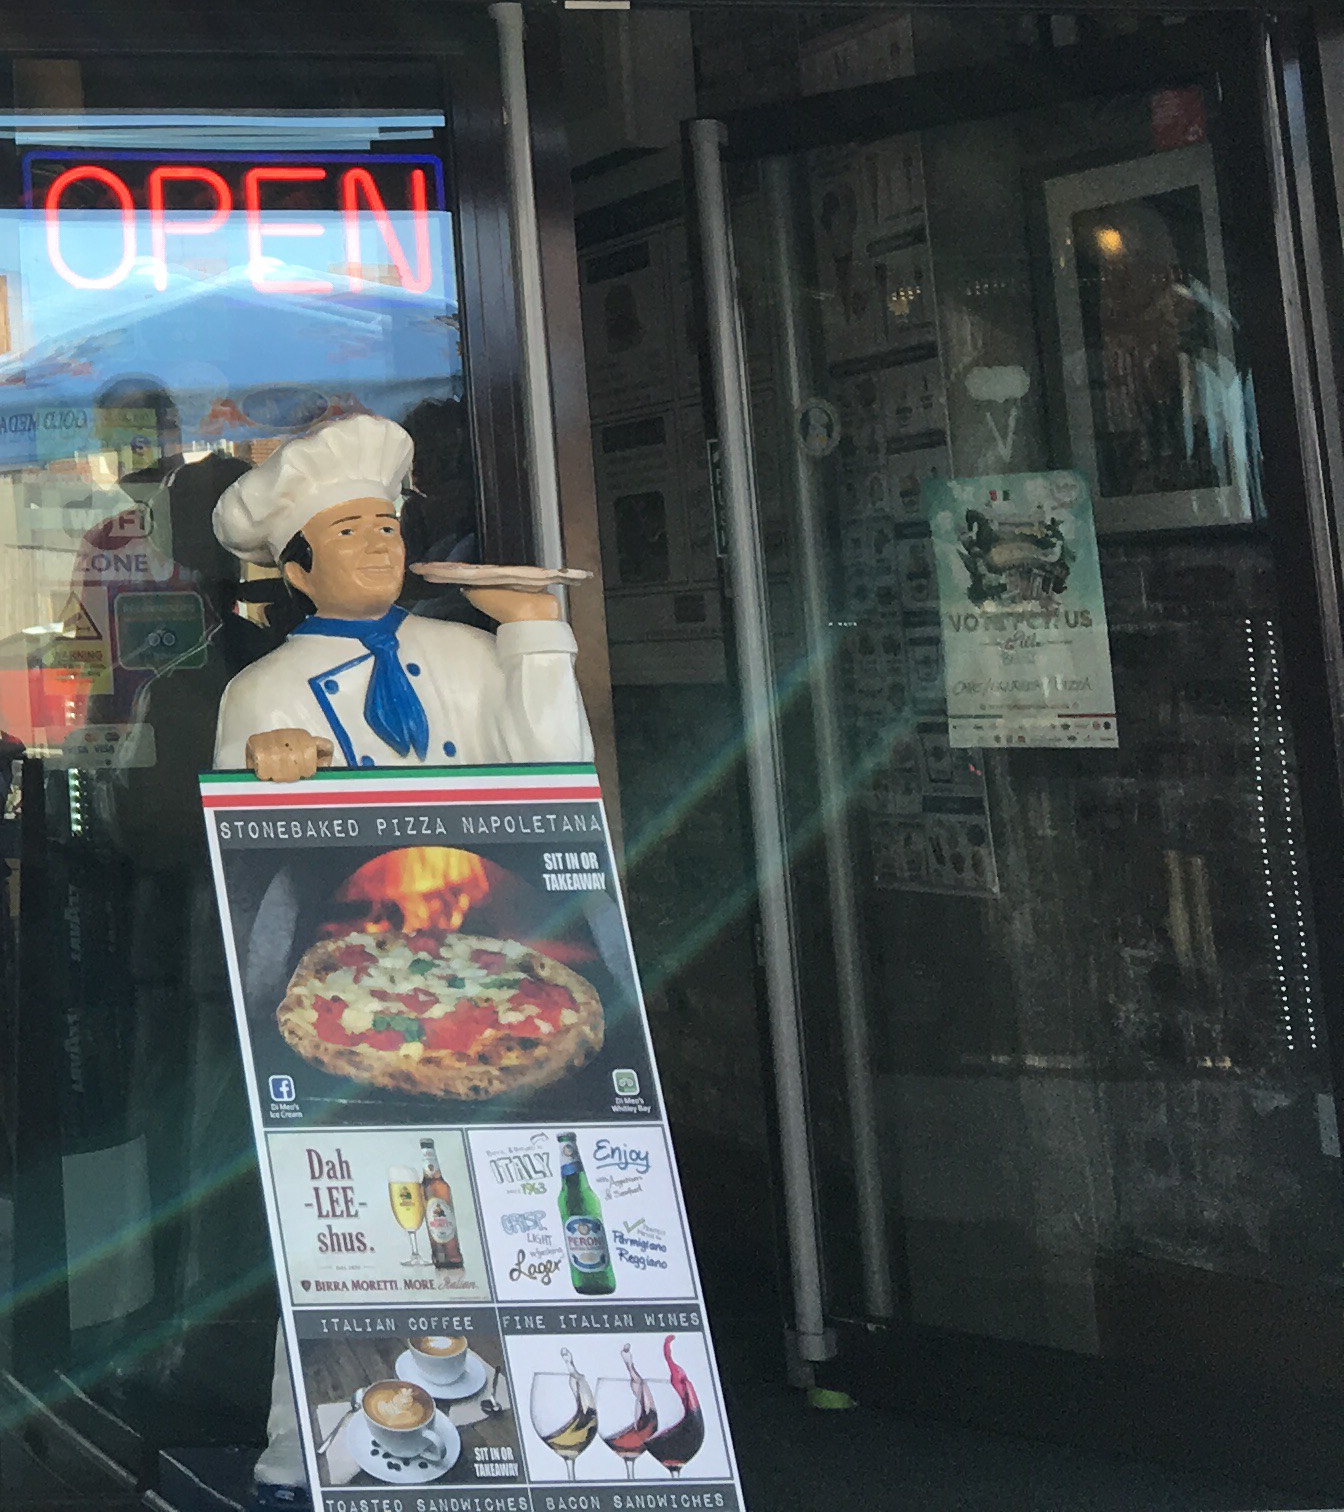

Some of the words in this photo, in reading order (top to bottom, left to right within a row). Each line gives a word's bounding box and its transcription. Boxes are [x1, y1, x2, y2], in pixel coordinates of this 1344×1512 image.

[44, 165, 432, 297] OPEN
[219, 818, 360, 840] STONEBAKED
[376, 816, 447, 836] PIZZA
[462, 813, 602, 835] NAPOLETANA
[543, 853, 564, 871] SIT
[564, 853, 580, 870] IN
[580, 852, 599, 869] OR
[543, 872, 606, 891] TAKEAWAY
[305, 1147, 353, 1182] Dah
[592, 1138, 652, 1175] Enjoy
[489, 1151, 555, 1185] ITALY
[303, 1185, 368, 1220] -LEE-
[316, 1224, 376, 1255] shus.
[526, 1232, 554, 1246] LIGHT
[611, 1230, 668, 1254] Parmigiano
[508, 1248, 562, 1286] Lager
[615, 1247, 668, 1270] Reggiano
[314, 1280, 350, 1292] BIRRA
[403, 1277, 437, 1291] MORE
[320, 1318, 397, 1333] ITALIAN
[408, 1316, 475, 1331] COFFEE
[501, 1315, 546, 1330] FINE
[559, 1313, 635, 1329] ITALIAN
[643, 1312, 701, 1328] WINES
[473, 1446, 490, 1462] SIT
[489, 1446, 500, 1461] IN
[500, 1446, 514, 1461] OR
[474, 1461, 520, 1478] TAKEAWAY
[325, 1498, 404, 1512] TOASTED
[415, 1496, 528, 1512] SANDWICHES
[545, 1495, 601, 1511] BACON
[613, 1493, 725, 1509] SANDWICHES
